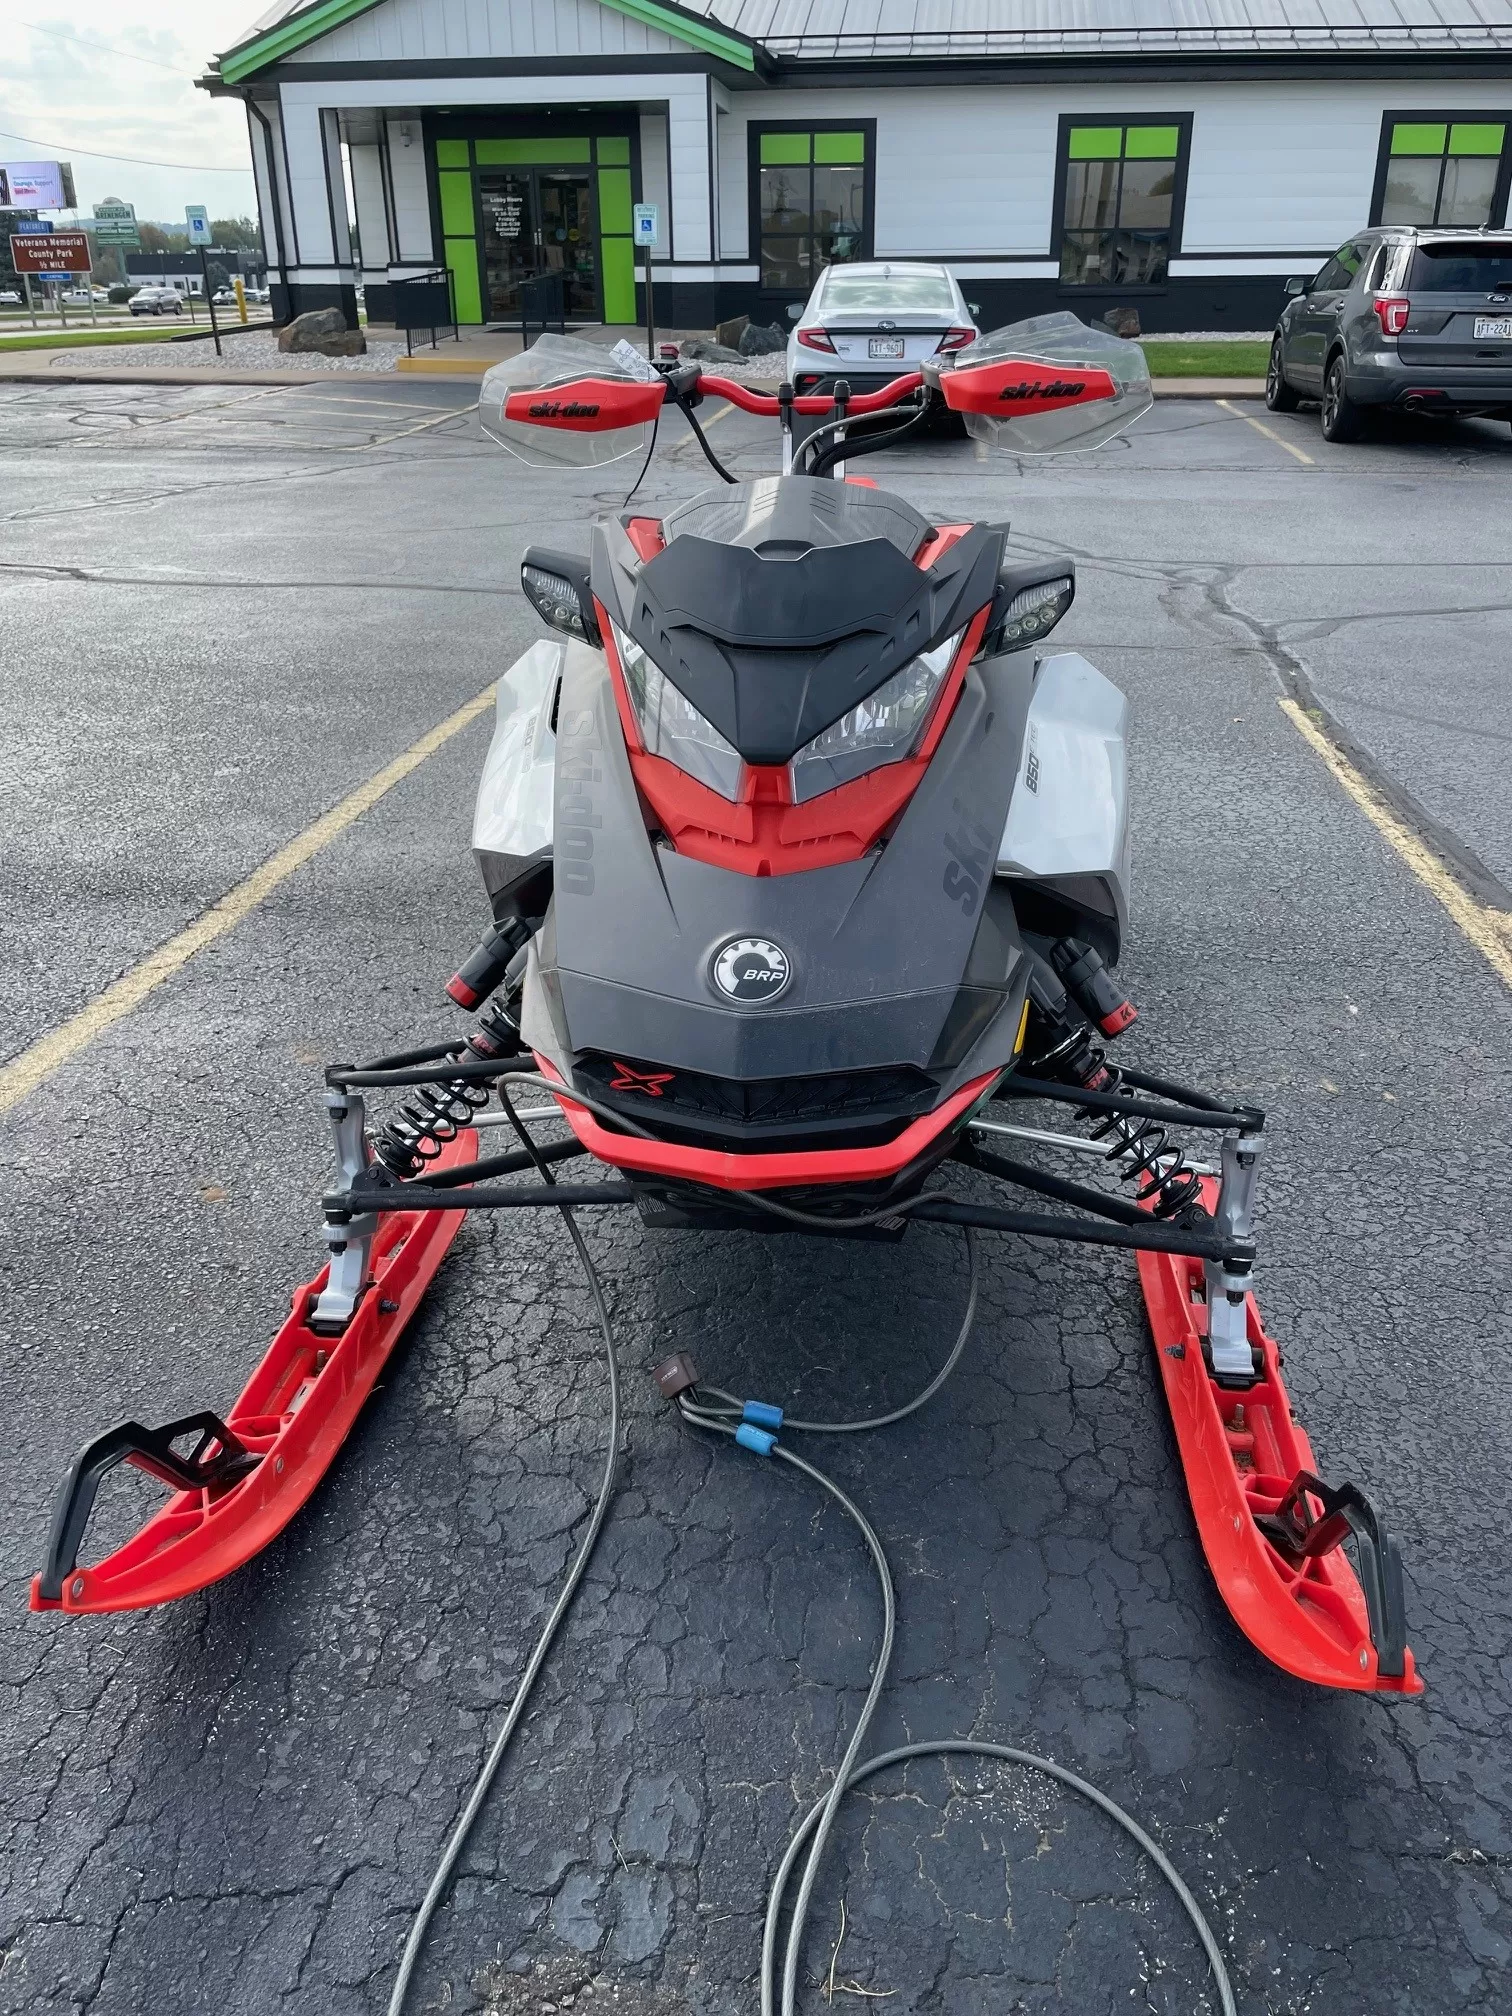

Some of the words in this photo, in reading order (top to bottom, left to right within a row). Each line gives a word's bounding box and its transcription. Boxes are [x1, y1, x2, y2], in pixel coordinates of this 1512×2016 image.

[15, 238, 48, 247] Veterans
[49, 237, 84, 246] Memorial
[28, 249, 54, 259] County
[56, 249, 73, 257] Park
[49, 261, 66, 269] MILE
[999, 380, 1086, 401] ski-doo
[528, 402, 601, 419] ski-doo
[1025, 752, 1040, 794] 850
[743, 969, 784, 982] BRP
